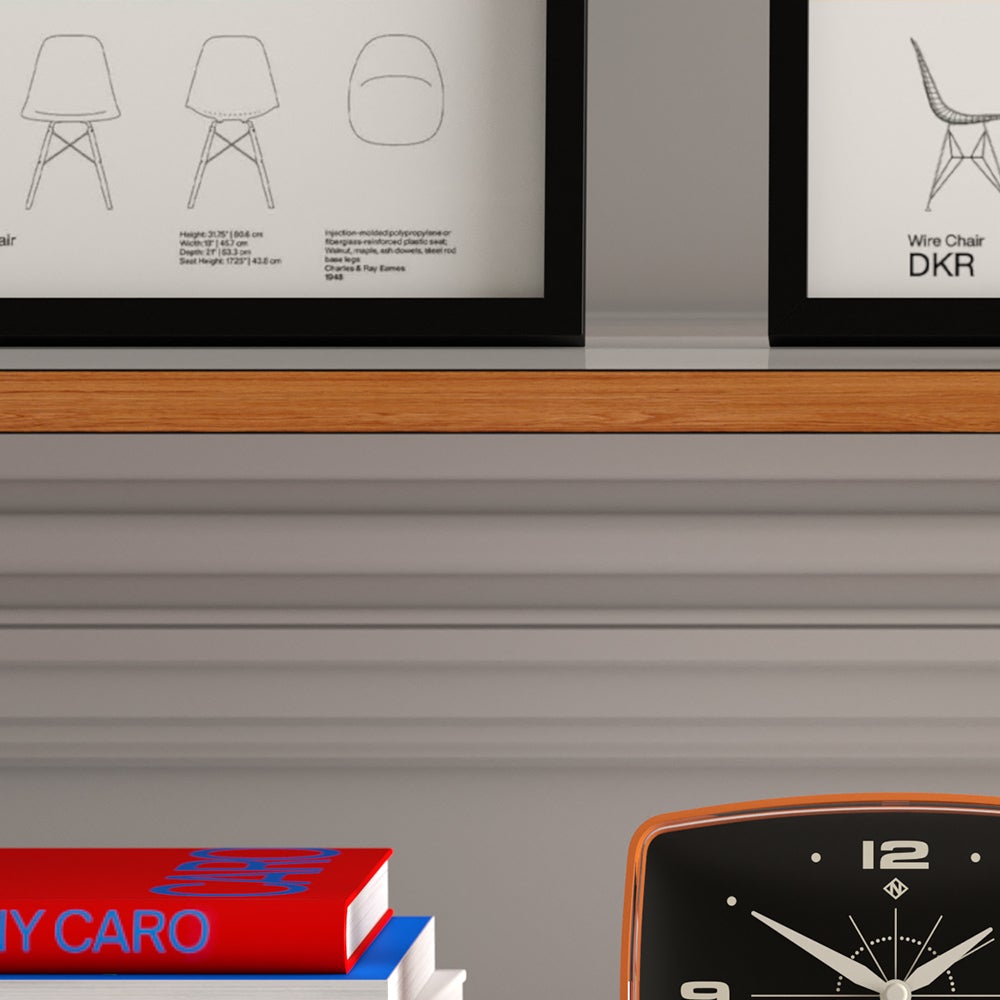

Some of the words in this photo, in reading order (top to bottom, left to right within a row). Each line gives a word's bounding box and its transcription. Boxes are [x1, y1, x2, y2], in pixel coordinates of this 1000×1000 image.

[908, 234, 942, 247] Wire
[945, 233, 985, 247] Chair
[909, 252, 975, 277] DKR
[862, 840, 929, 870] 12
[149, 848, 341, 897] CARO
[54, 908, 210, 953] CARO
